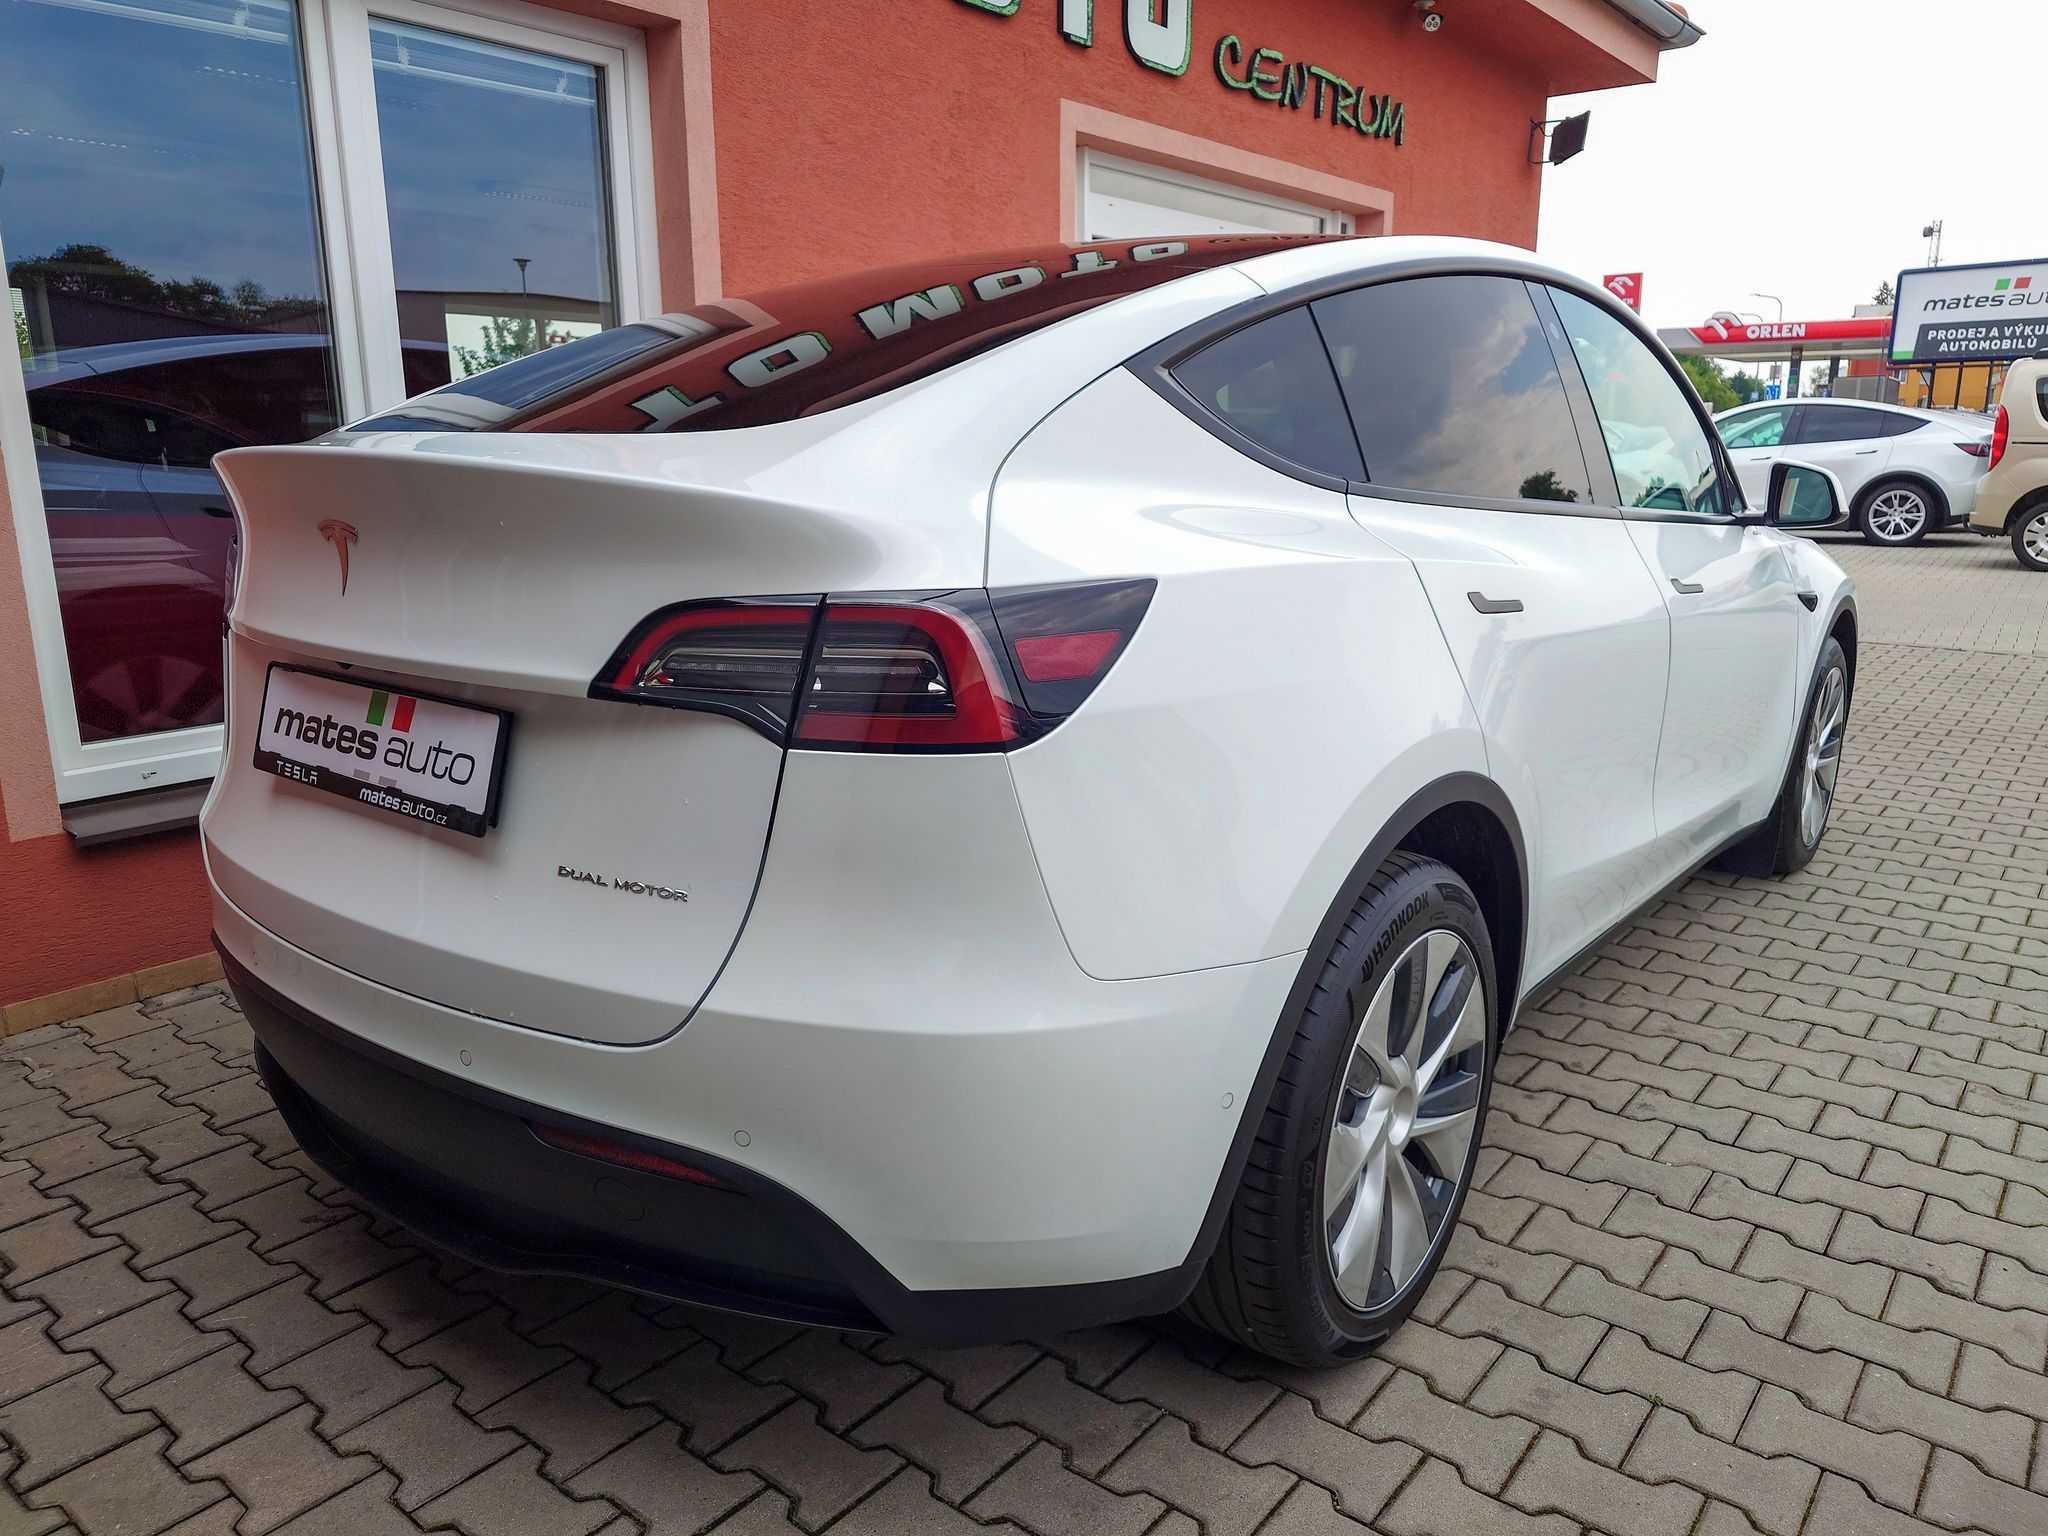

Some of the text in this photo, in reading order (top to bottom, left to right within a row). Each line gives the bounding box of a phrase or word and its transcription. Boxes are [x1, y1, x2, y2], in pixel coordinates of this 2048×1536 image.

[1213, 34, 1405, 146] CENTRUM
[1923, 294, 2006, 311] mates
[1746, 323, 1806, 339] ORLEN
[1927, 322, 2048, 341] PRODEJ A VÝKU
[1939, 336, 2037, 352] AUTOMOBILŮ
[273, 707, 476, 786] mates auto
[276, 759, 319, 786] TESLA
[558, 865, 689, 902] DUAL MOTOR
